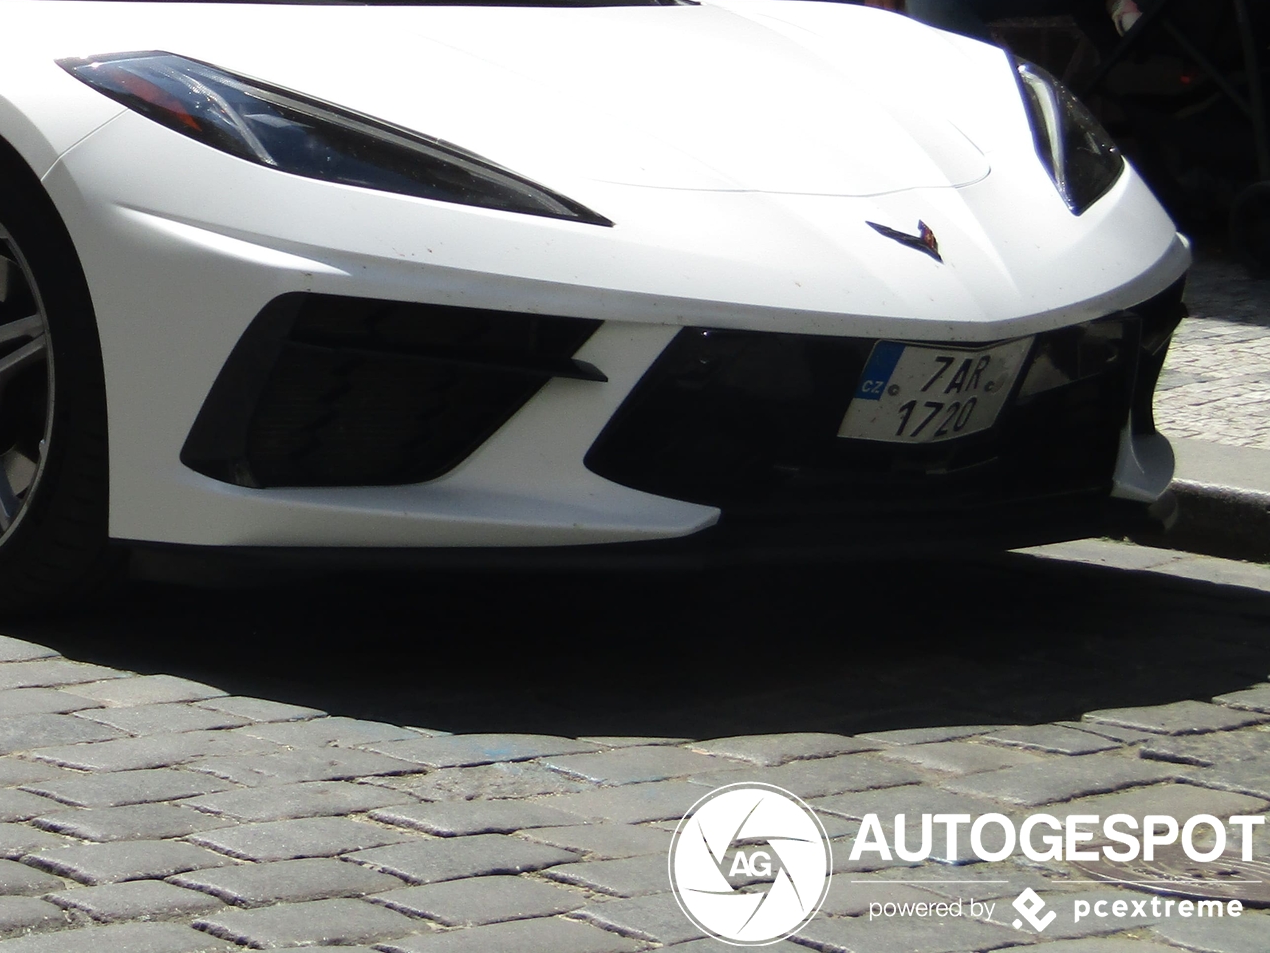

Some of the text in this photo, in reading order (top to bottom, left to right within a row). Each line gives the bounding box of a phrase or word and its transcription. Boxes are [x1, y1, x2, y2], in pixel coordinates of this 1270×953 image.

[861, 379, 885, 395] CZ
[921, 355, 991, 395] 7AR
[895, 397, 978, 438] 1720
